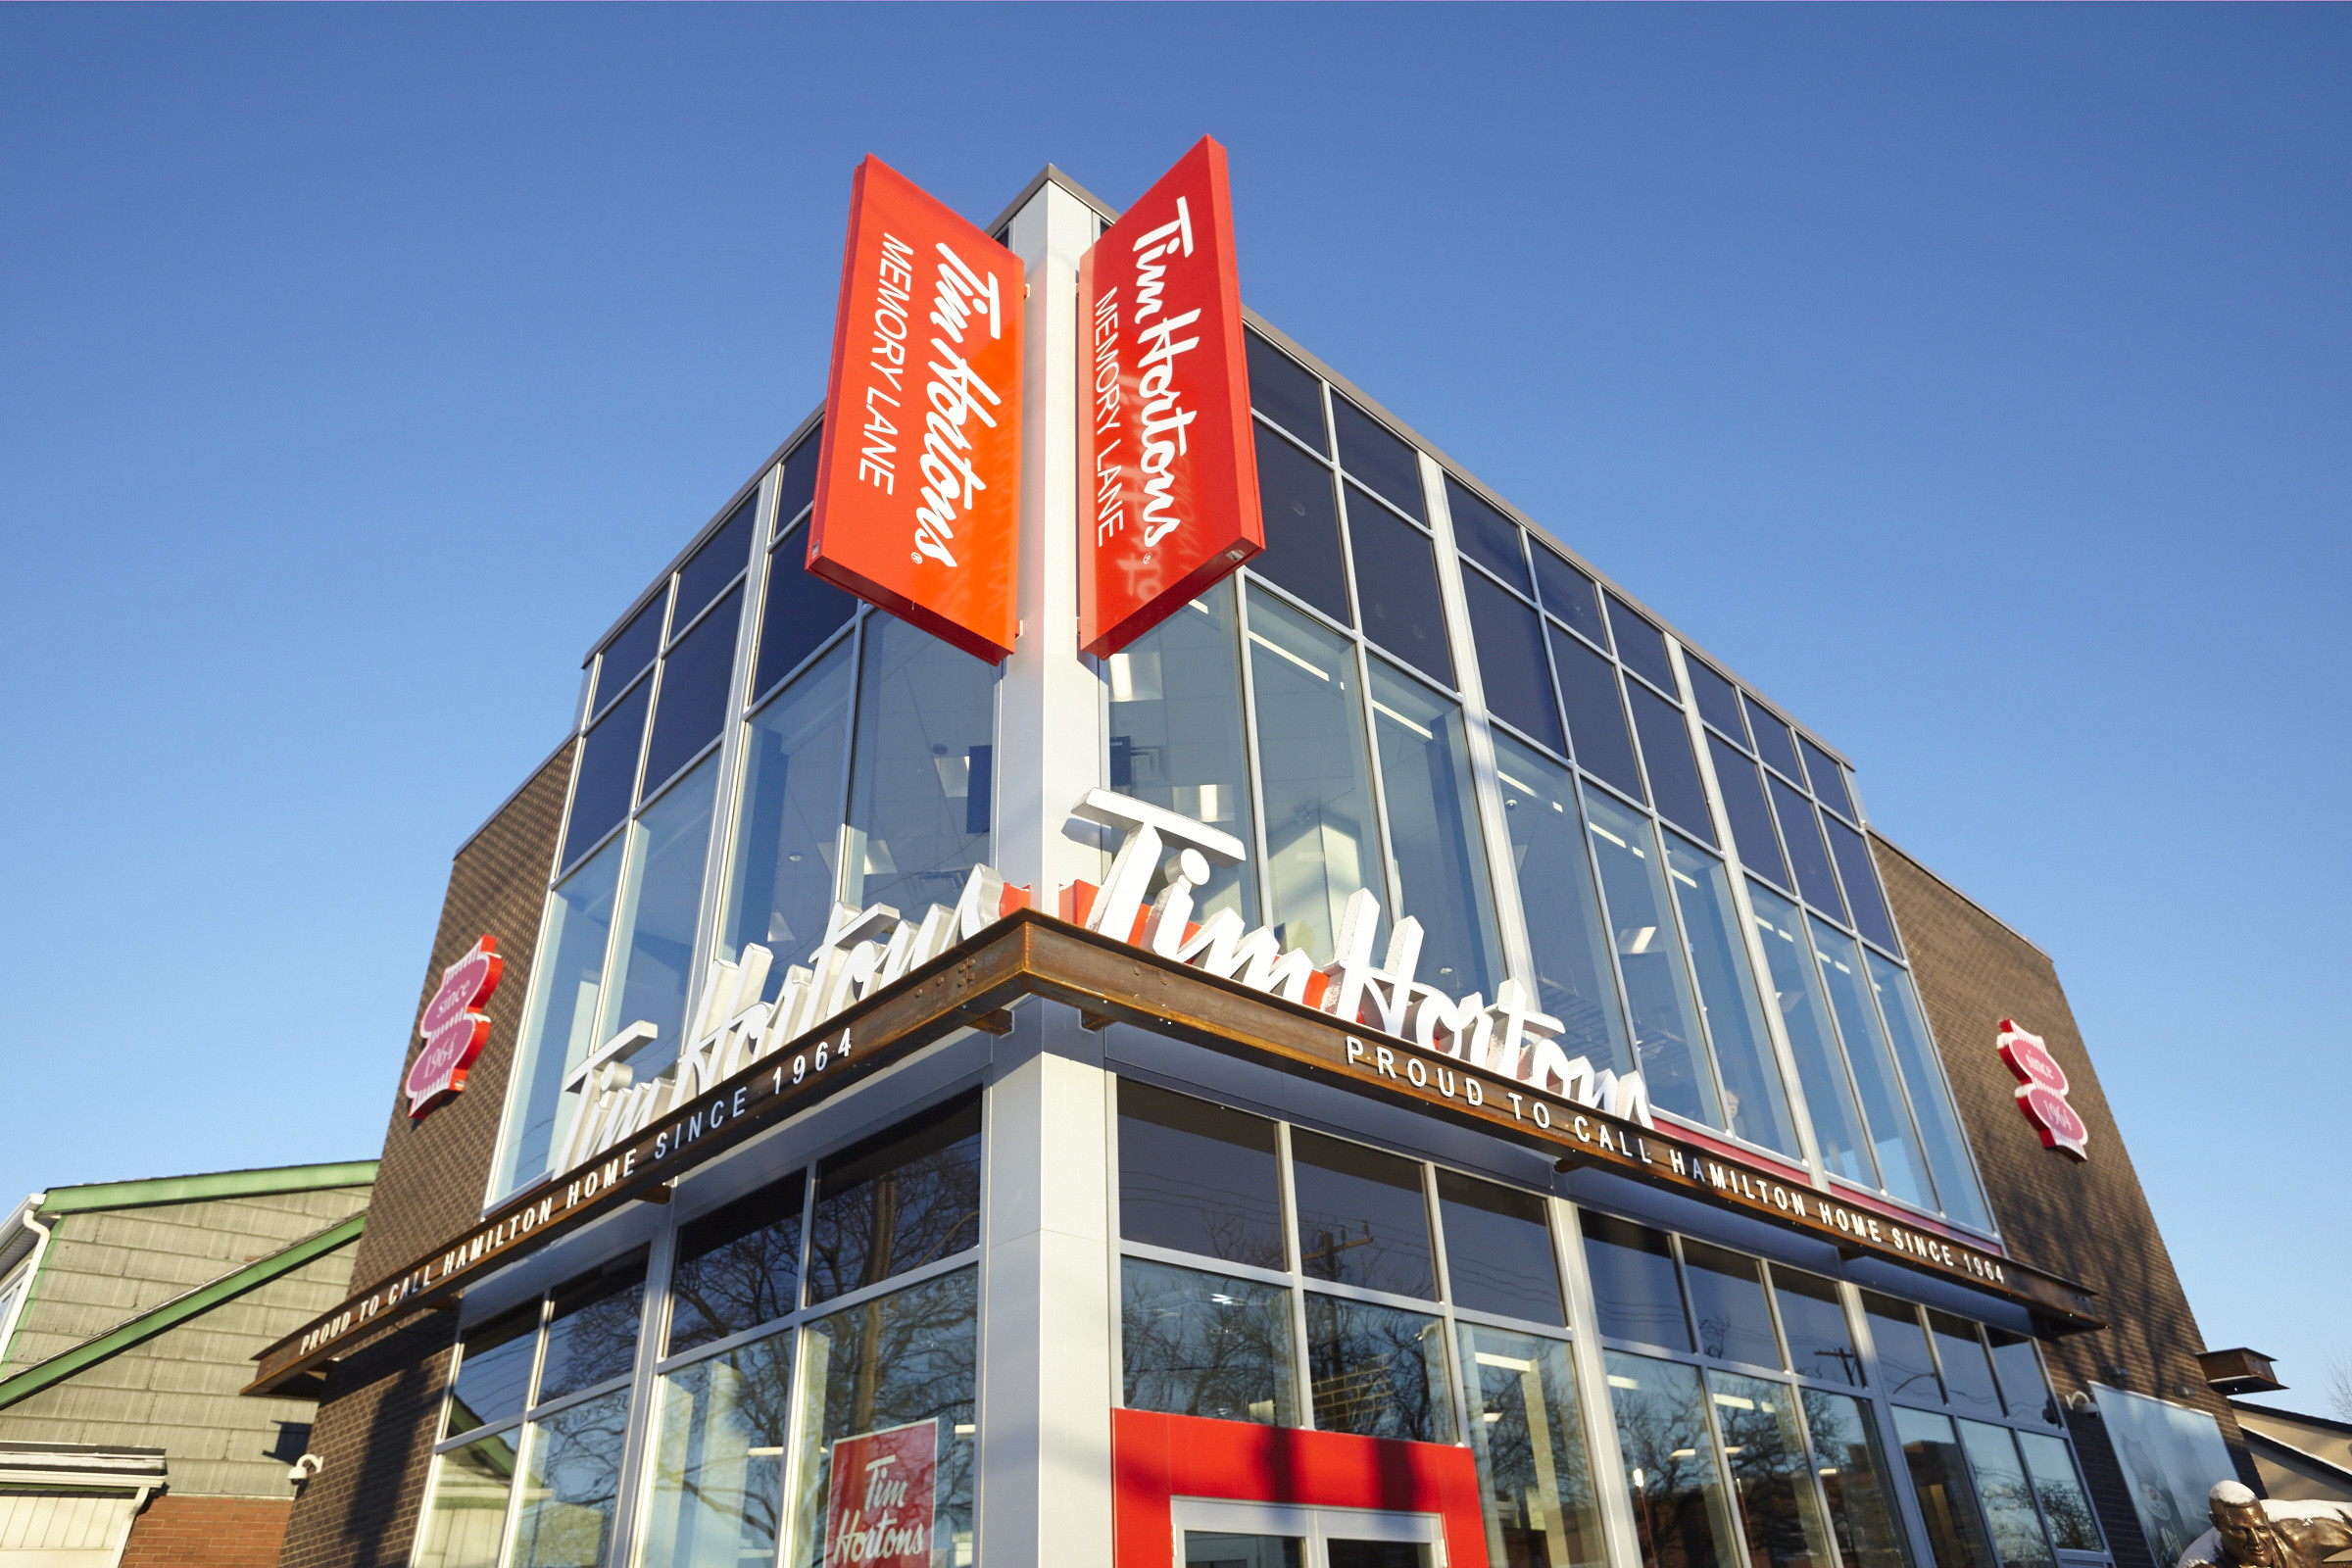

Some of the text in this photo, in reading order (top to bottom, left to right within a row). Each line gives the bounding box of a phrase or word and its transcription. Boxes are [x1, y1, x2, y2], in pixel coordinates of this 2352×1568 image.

[1132, 196, 1194, 324] Tim
[858, 232, 914, 496] MEMORY LANE
[914, 242, 1002, 567] Tim Hortons
[1094, 286, 1124, 548] MEMORY LANE
[1138, 308, 1201, 548] Hortons
[436, 980, 471, 1019] since
[1071, 787, 1655, 1129] Tim Hortons
[423, 1032, 458, 1078] 1964
[552, 1020, 676, 1182] Tim
[2025, 1050, 2054, 1080] since
[2043, 1100, 2073, 1131] 1964
[300, 1028, 852, 1355] PROUD TO CALL HAMILTON HOME SINCE 1964
[1347, 1036, 2005, 1284] PROUD TO CALL HAMILTON HOME SINCE 1964
[833, 1508, 923, 1564] Hortons
[864, 1455, 907, 1512] Tim
